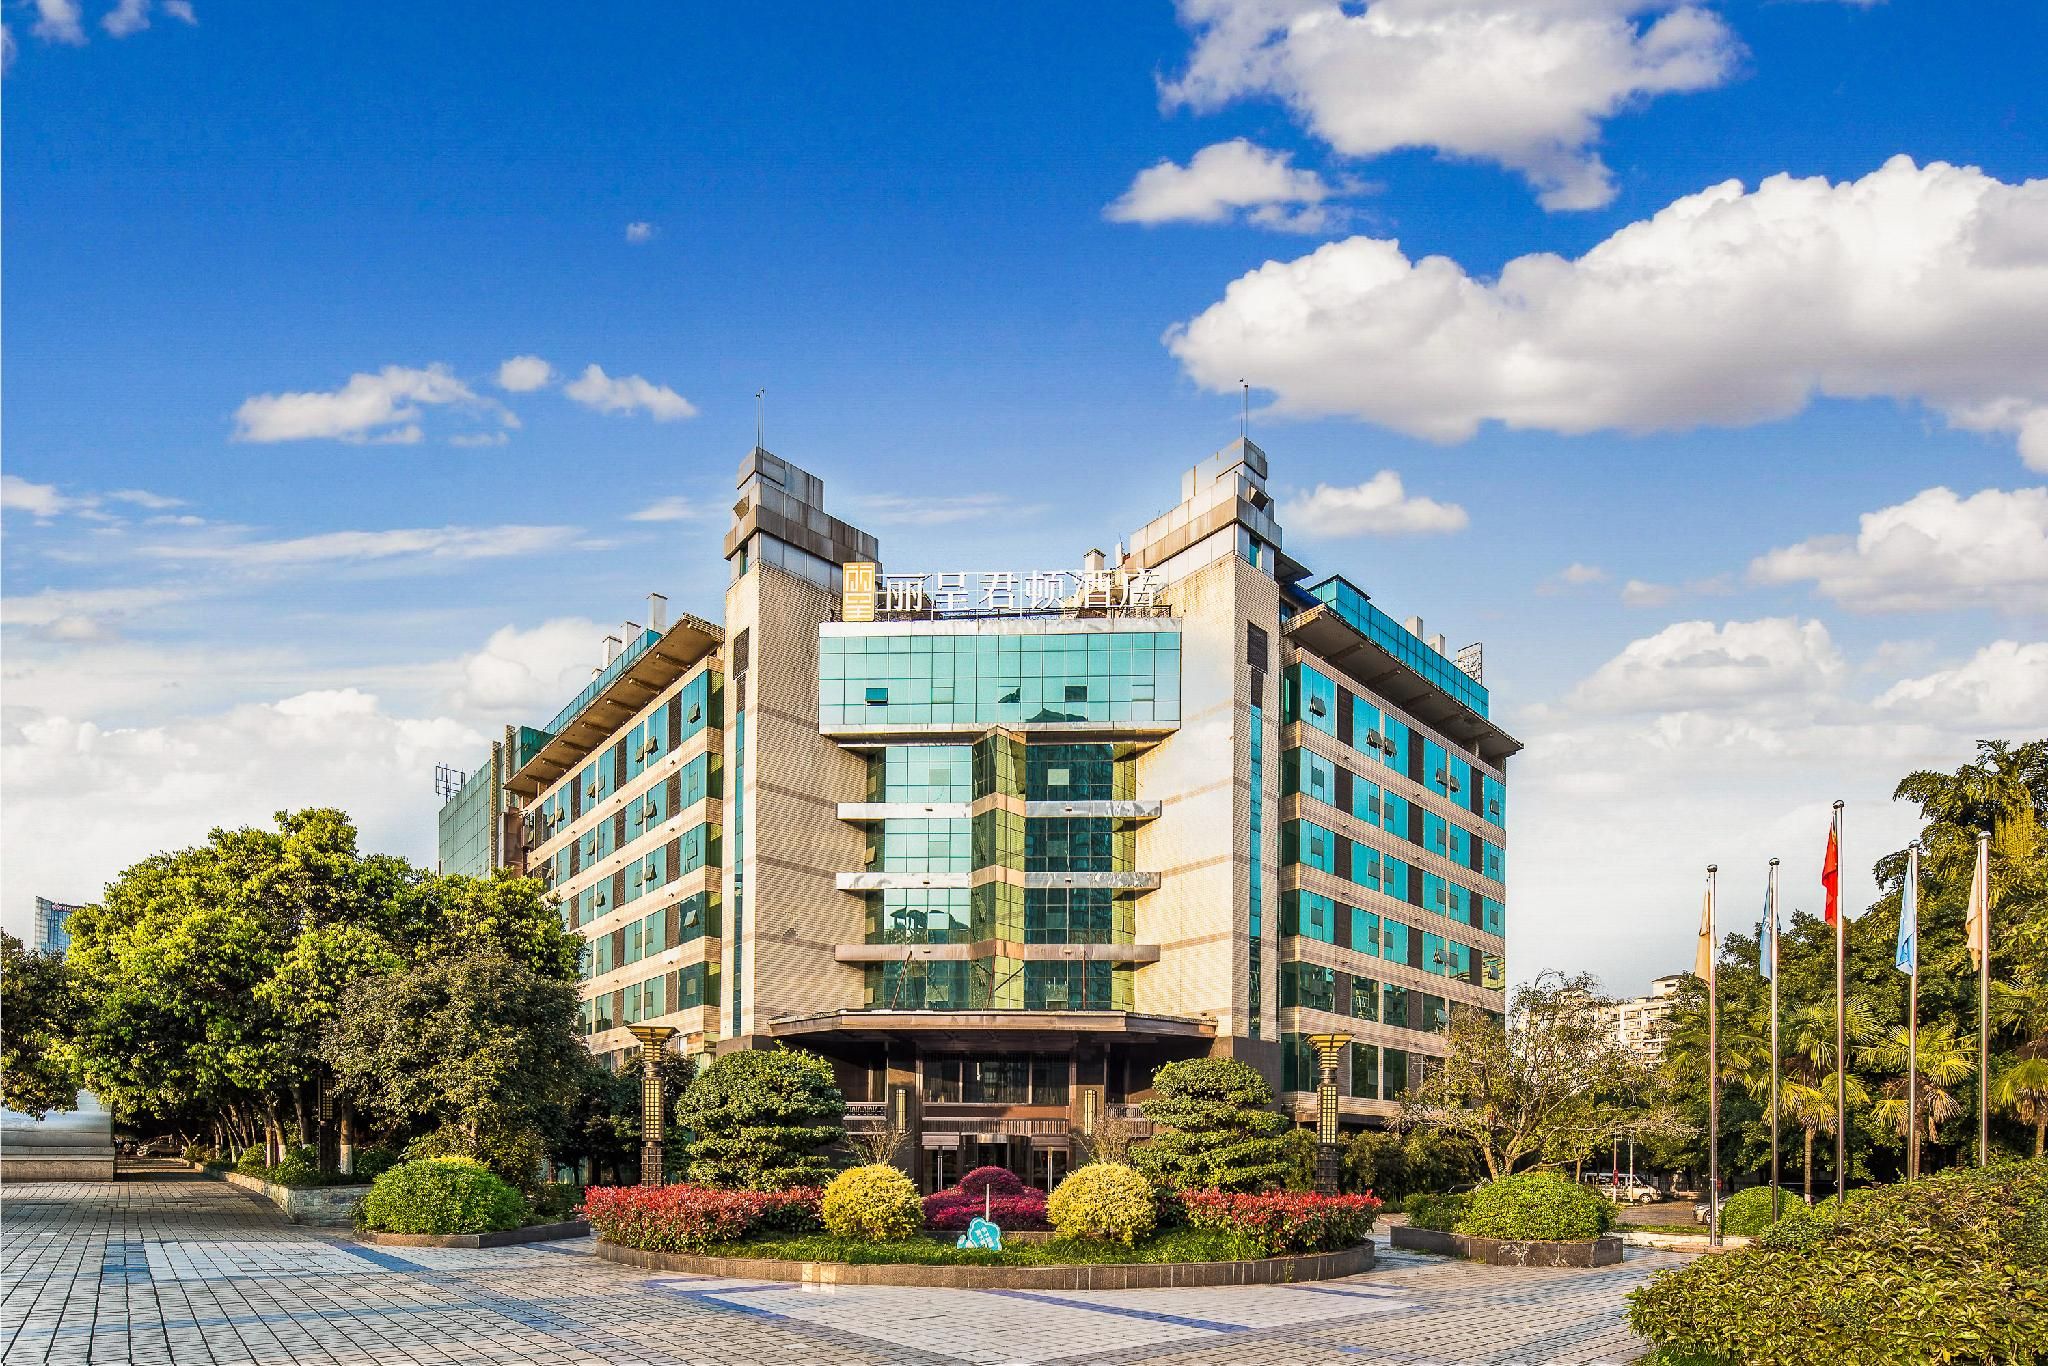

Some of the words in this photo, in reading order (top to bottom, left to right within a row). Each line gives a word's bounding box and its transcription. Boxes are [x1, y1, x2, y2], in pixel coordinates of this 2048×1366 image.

[885, 569, 1159, 611] 丽呈君顿酒店
